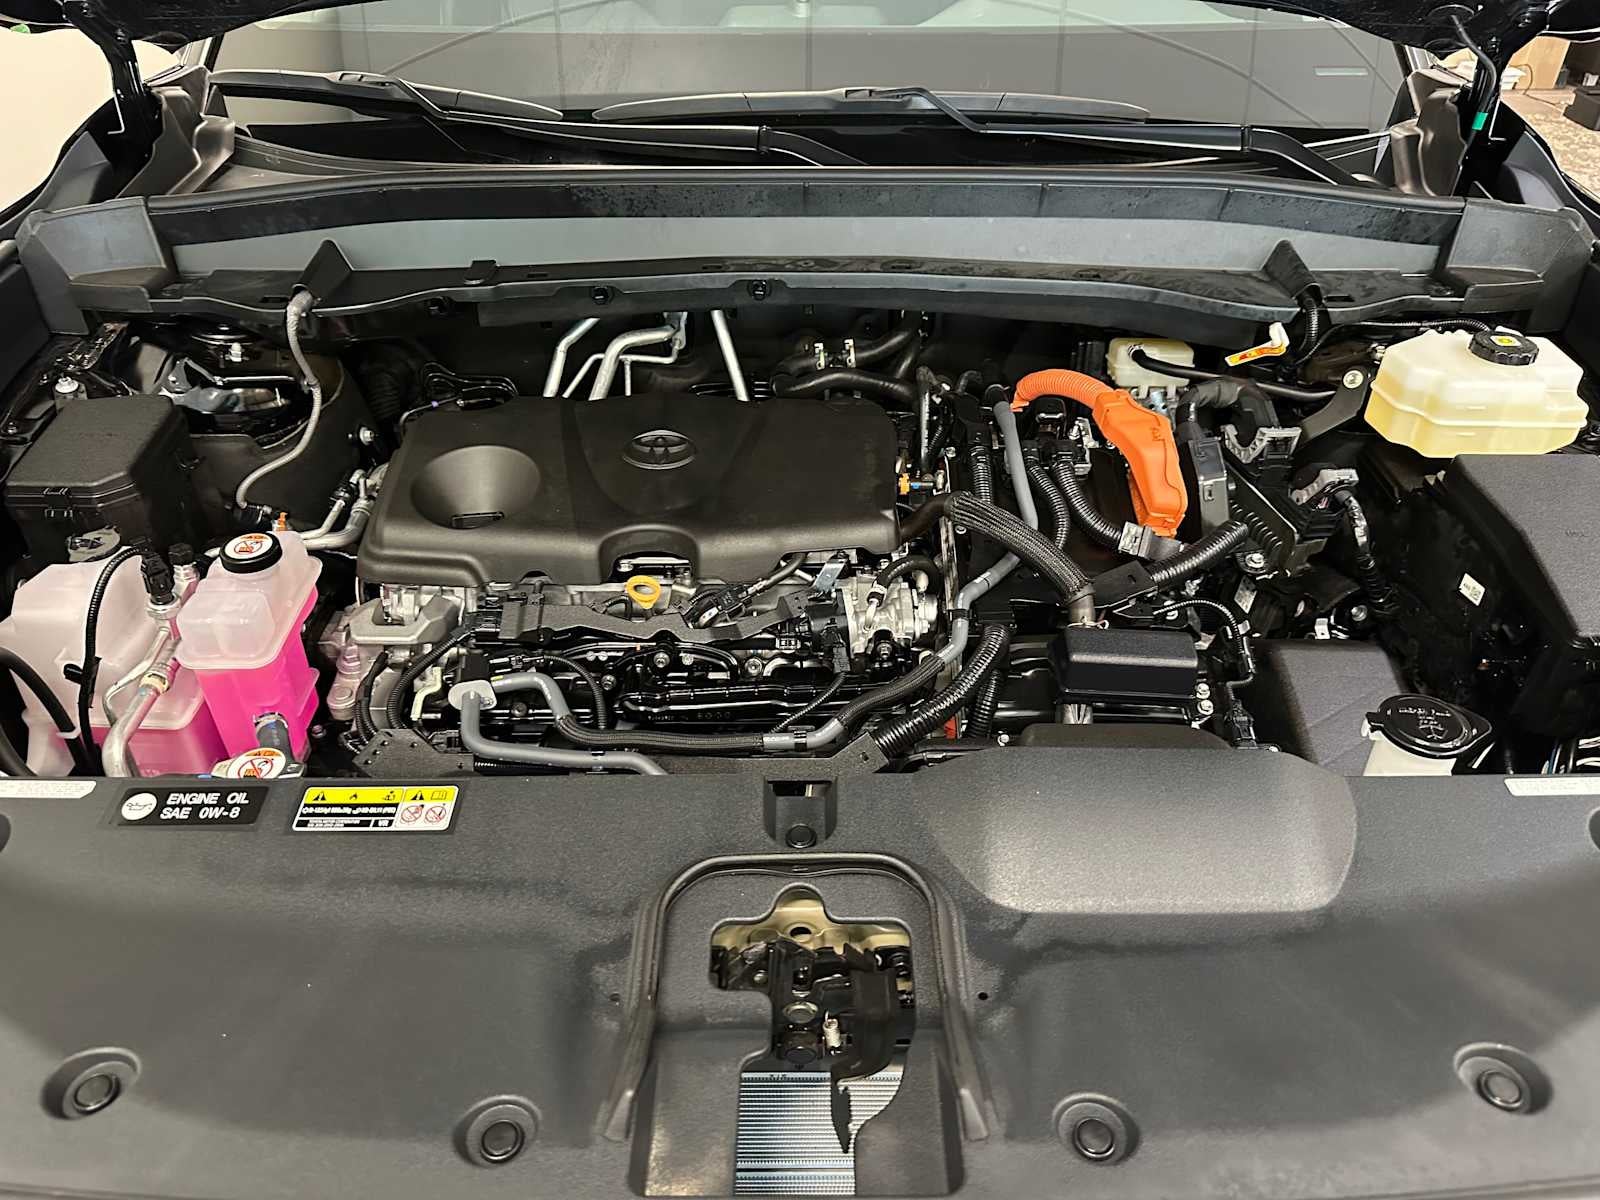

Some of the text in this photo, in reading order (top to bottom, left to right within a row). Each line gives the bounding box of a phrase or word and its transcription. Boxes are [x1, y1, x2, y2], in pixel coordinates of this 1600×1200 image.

[166, 791, 250, 805] ENGINE OIL
[160, 806, 241, 820] SAE 0W-8
